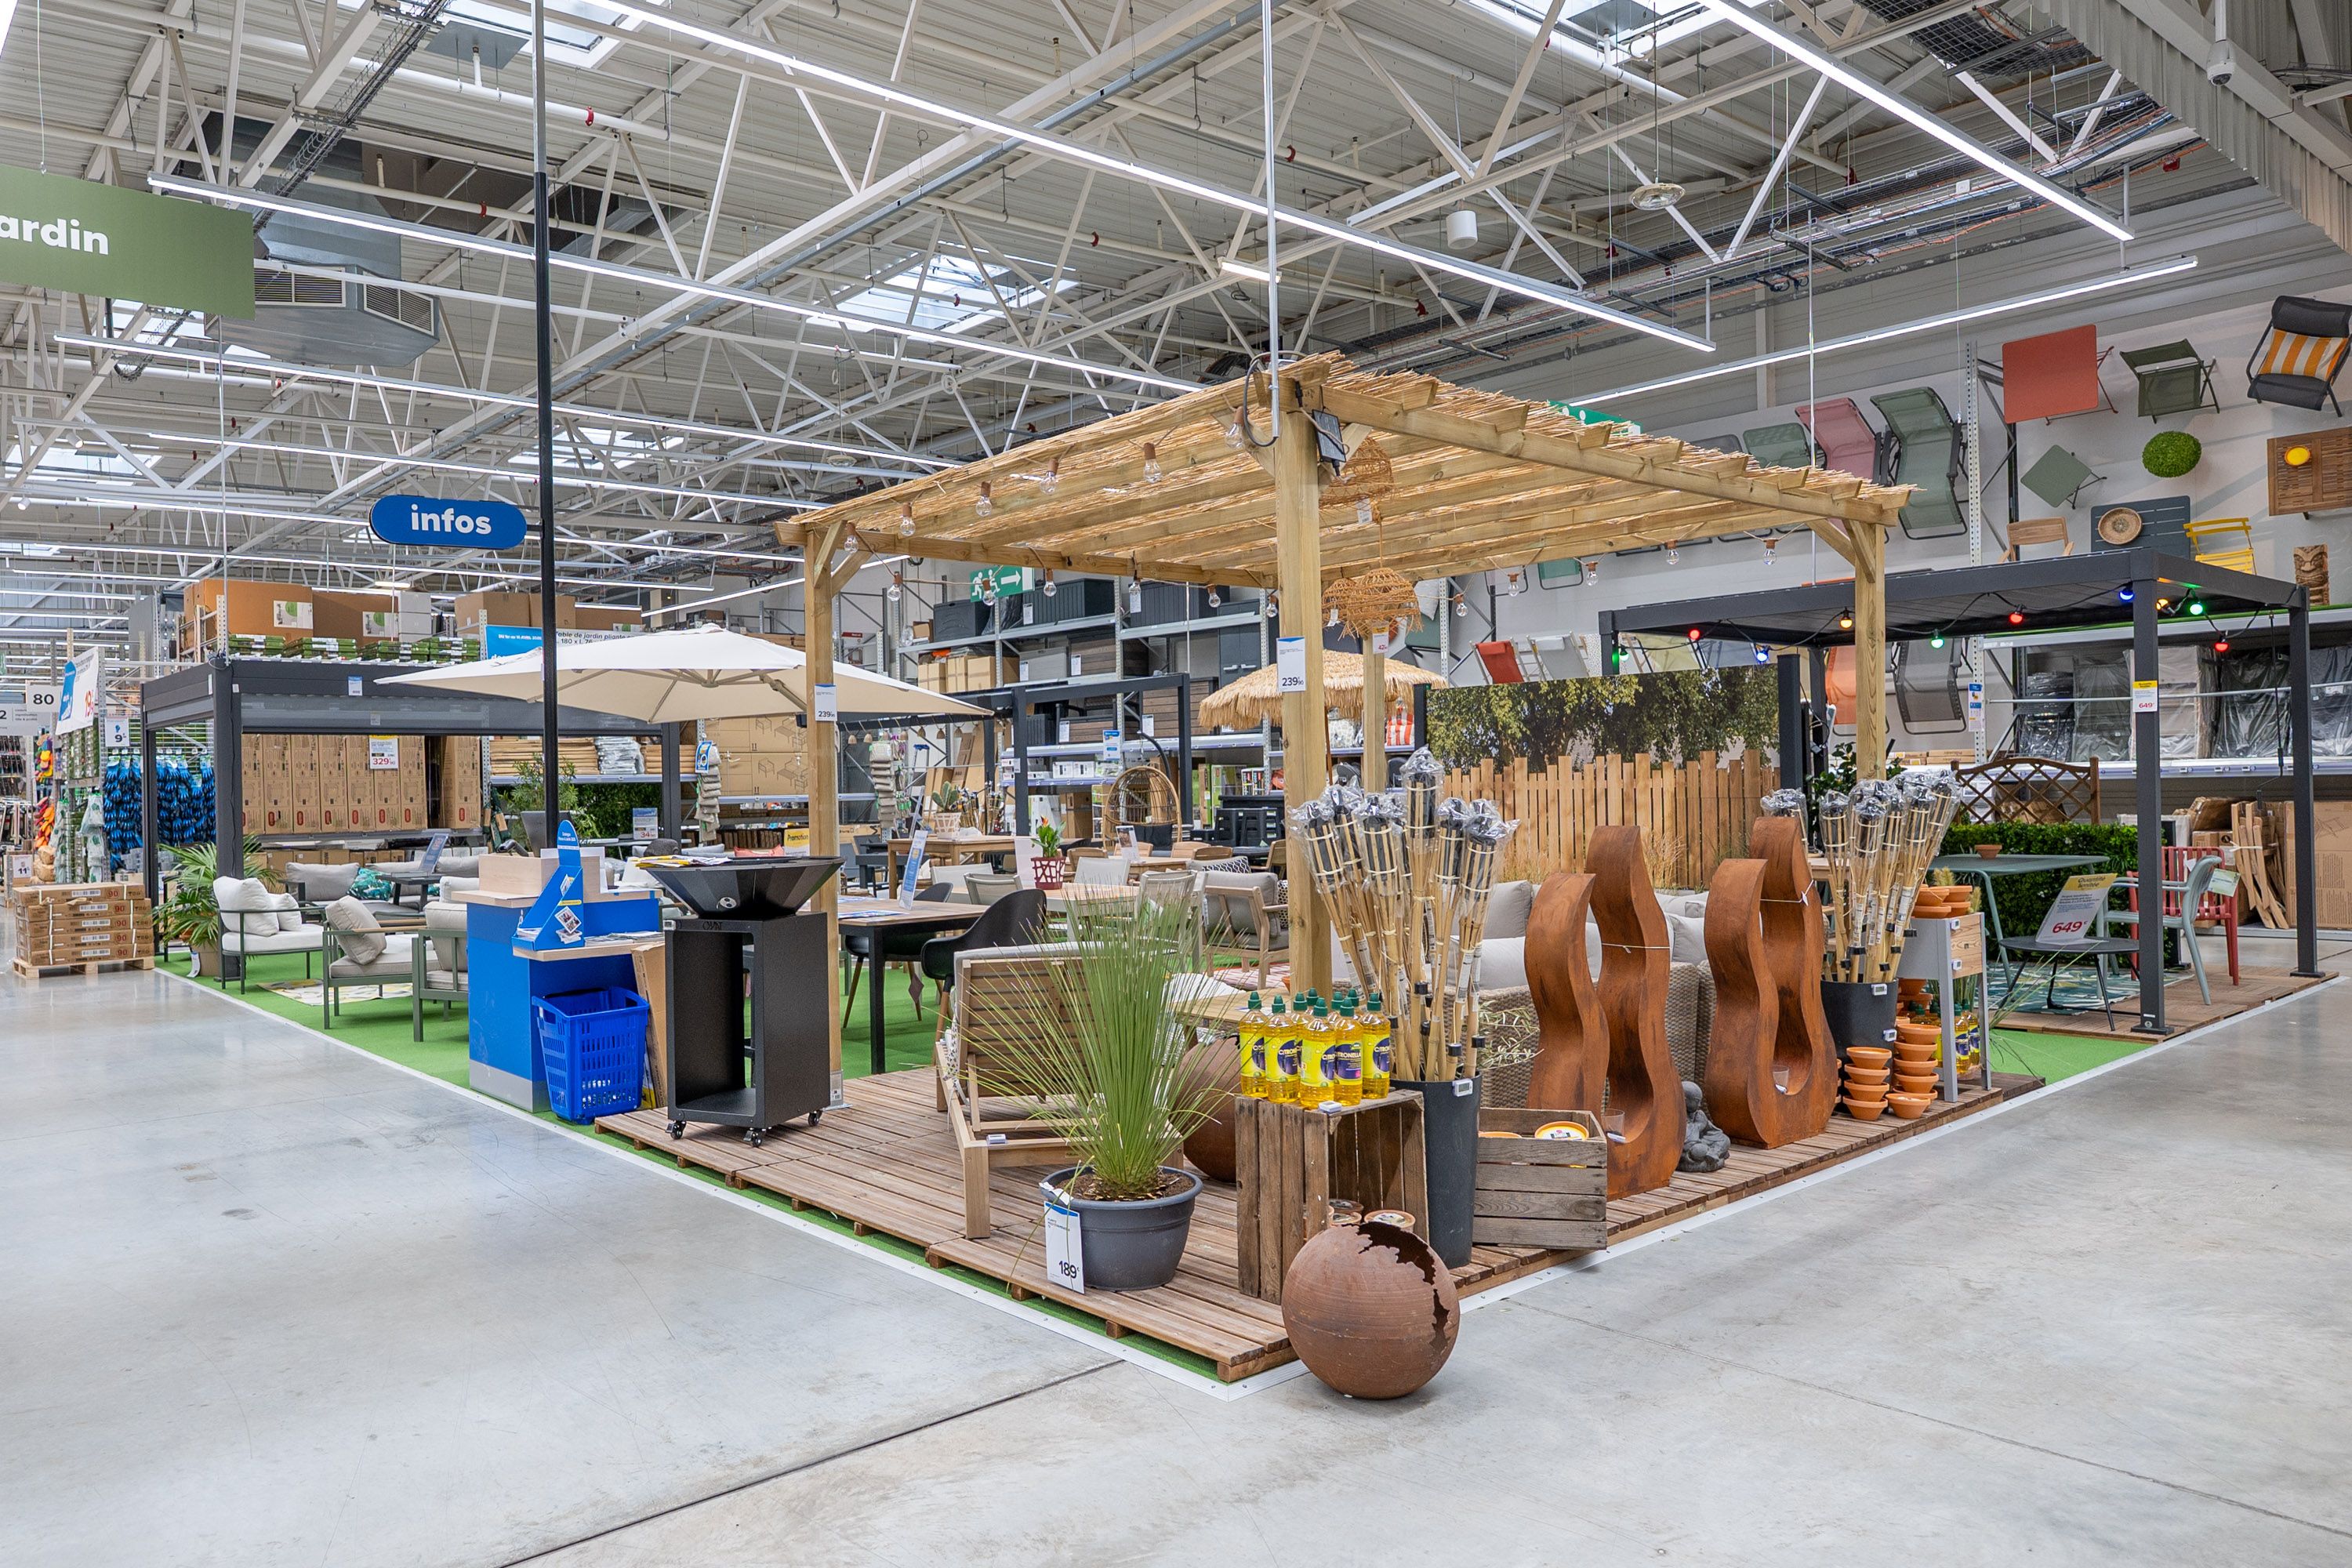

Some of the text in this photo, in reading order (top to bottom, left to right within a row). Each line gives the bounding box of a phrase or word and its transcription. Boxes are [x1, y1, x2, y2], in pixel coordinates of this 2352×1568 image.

[0, 215, 109, 256] ardin
[411, 503, 492, 535] infos
[33, 694, 55, 705] 80
